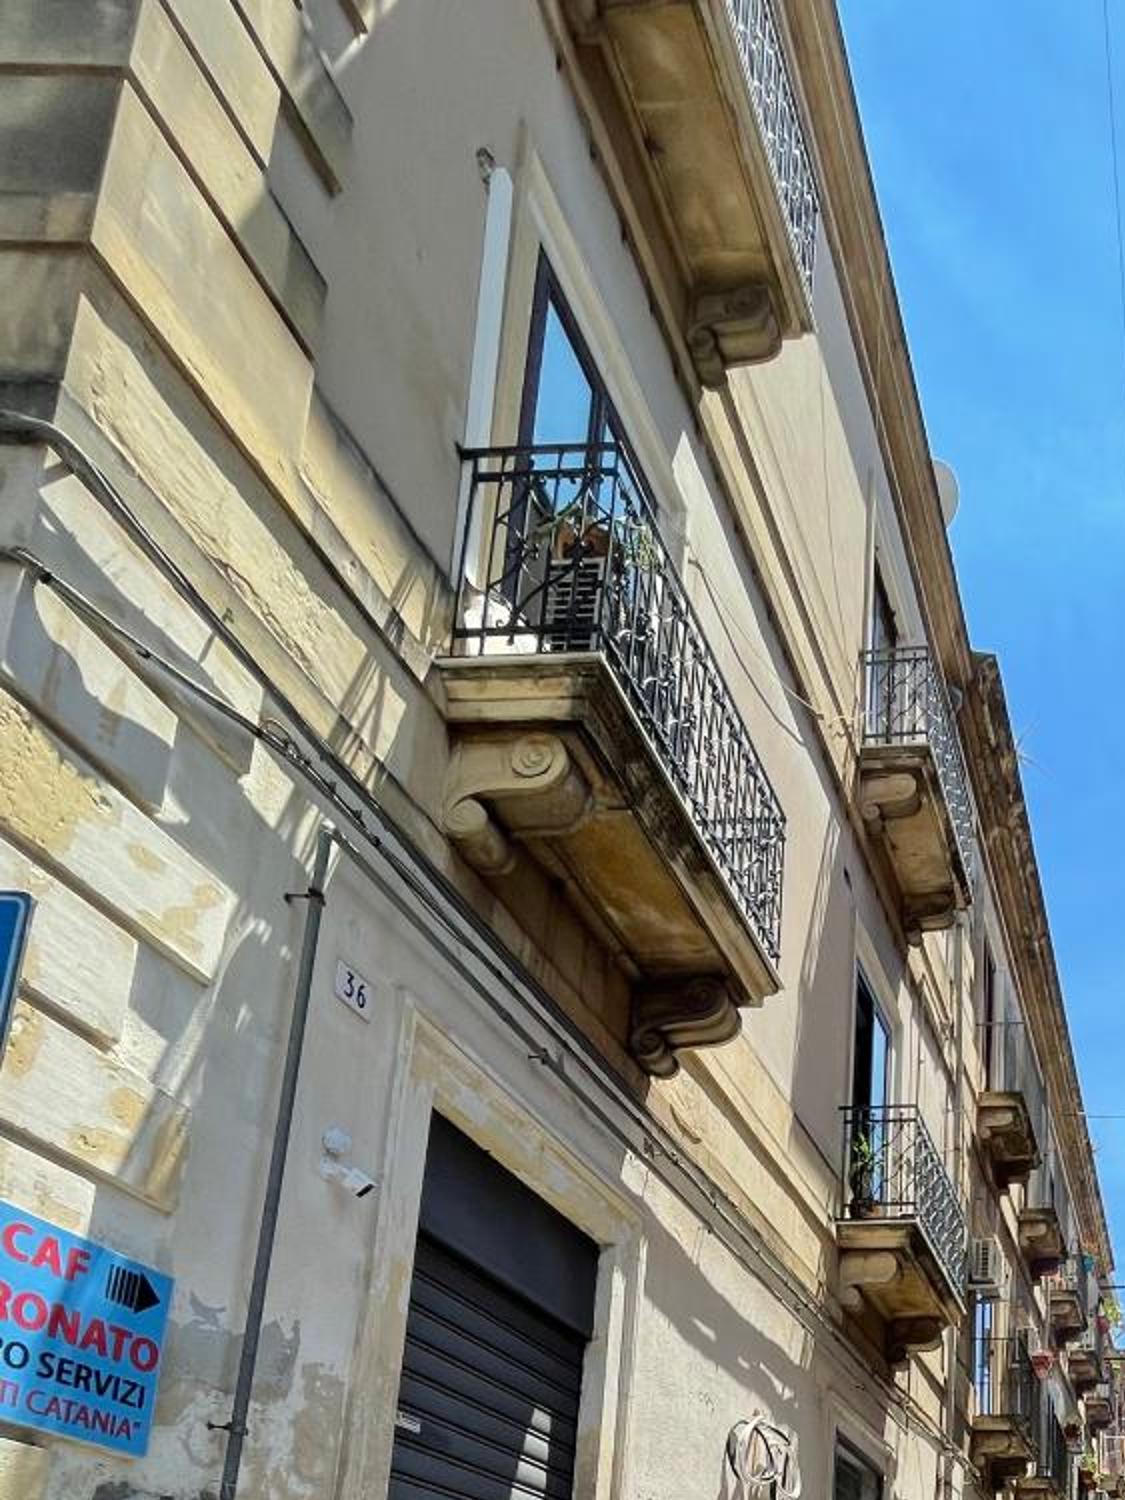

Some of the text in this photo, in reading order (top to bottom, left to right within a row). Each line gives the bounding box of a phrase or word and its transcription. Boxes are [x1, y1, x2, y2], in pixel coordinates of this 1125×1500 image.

[344, 971, 366, 1008] 36
[2, 1222, 91, 1281] CAF
[0, 1337, 145, 1410] O SERVIZI
